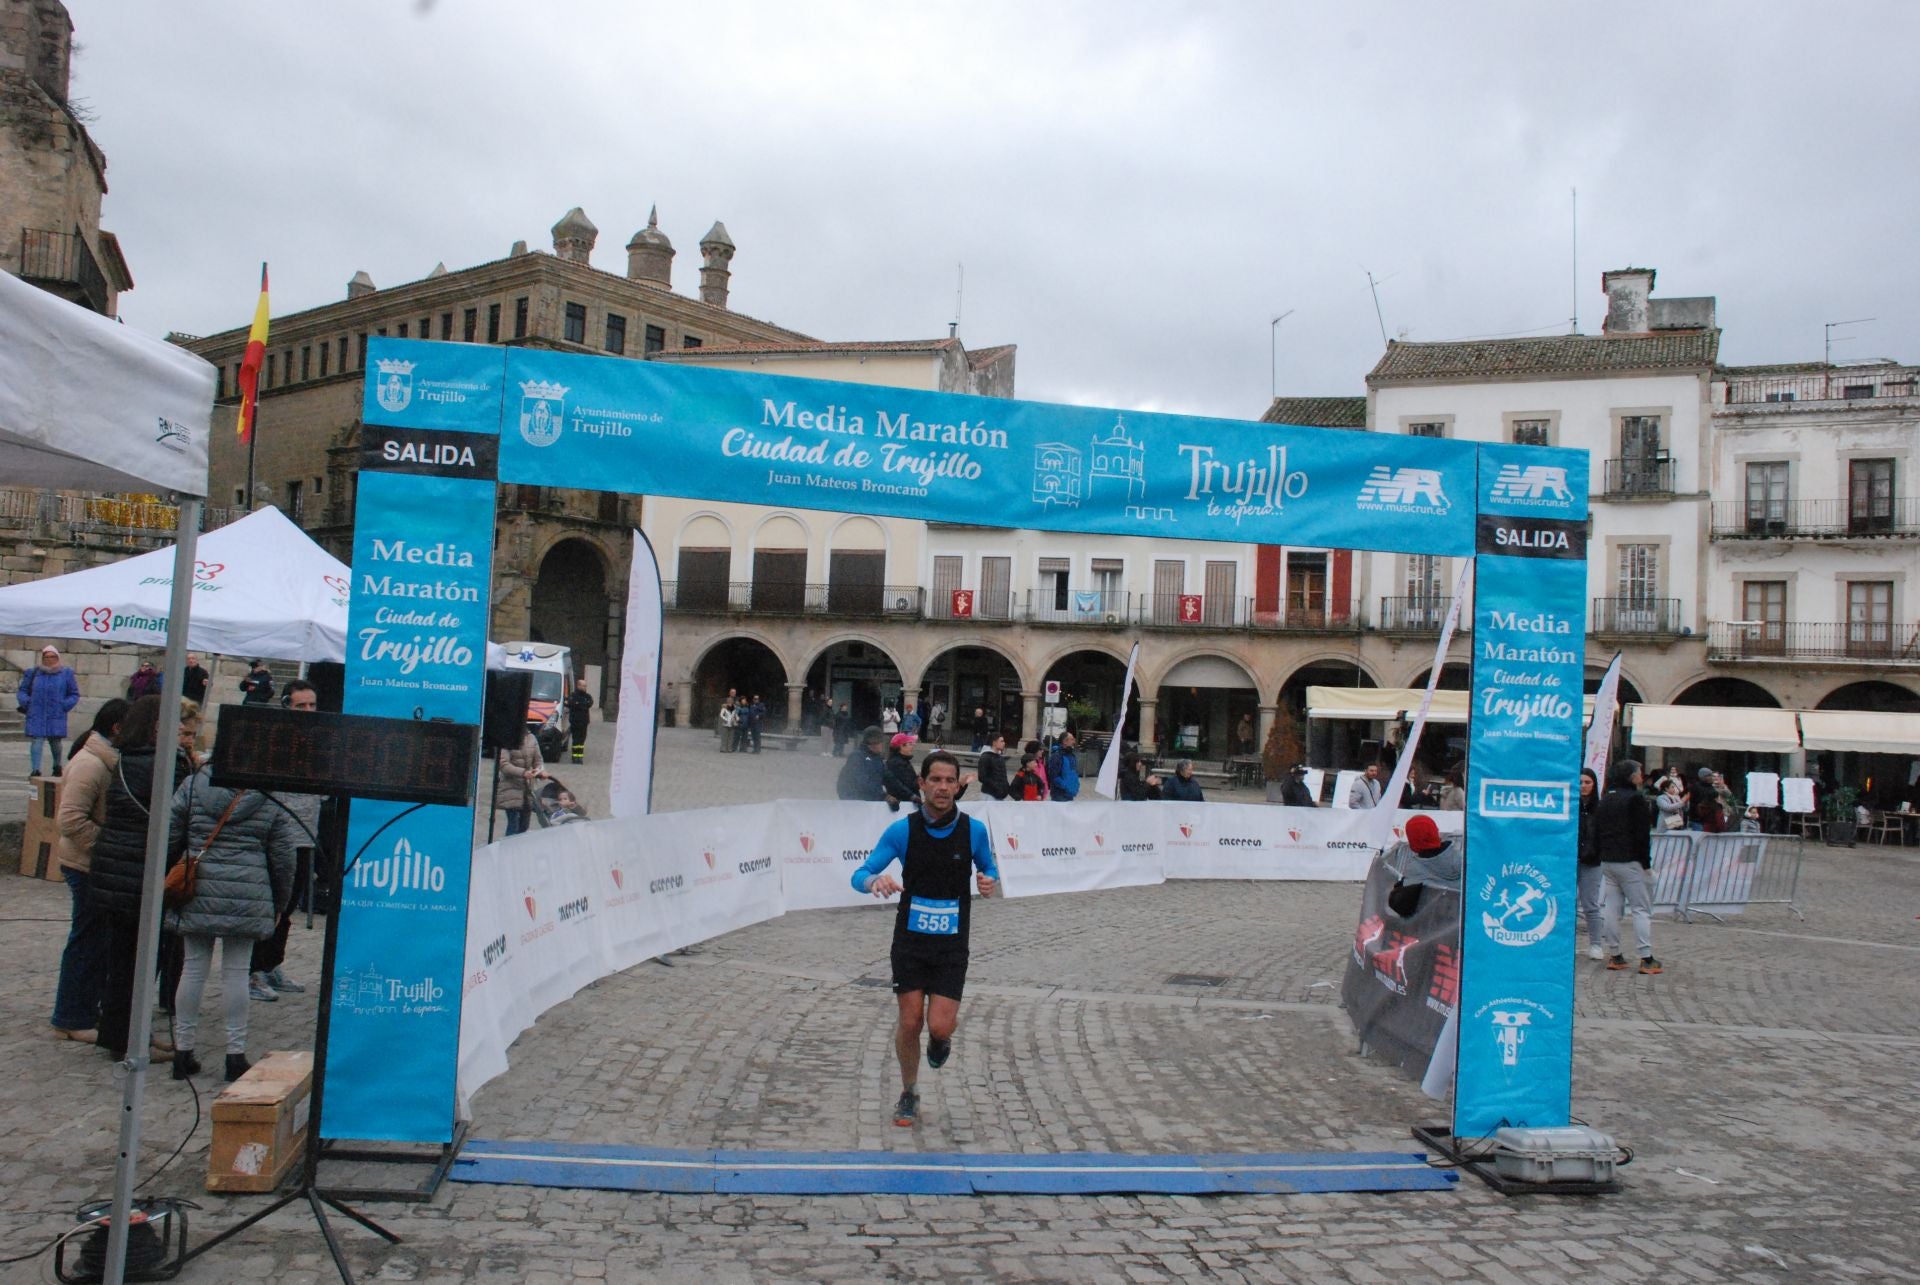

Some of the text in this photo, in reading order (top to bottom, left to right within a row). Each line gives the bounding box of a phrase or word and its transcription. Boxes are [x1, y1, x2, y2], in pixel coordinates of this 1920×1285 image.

[418, 389, 466, 405] Trujillo
[573, 405, 664, 423] Ayuntamiento de
[761, 398, 1008, 449] Media Maratón
[571, 418, 632, 438] Trujillo
[383, 440, 476, 467] SALIDA
[721, 428, 983, 486] Ciudad de Trujillo
[767, 470, 929, 497] Juan Mateos Broncano
[1178, 443, 1309, 509] Trujillo
[1207, 496, 1221, 516] te
[1356, 501, 1448, 516] www.musicrun.es
[1489, 495, 1570, 508] www.musicrun.es
[1495, 527, 1569, 549] SALIDA
[371, 539, 474, 568] Media
[361, 574, 479, 602] Maratón
[375, 606, 461, 628] Ciudad de
[1489, 610, 1571, 634] Media
[359, 627, 473, 675] Trujillo
[1484, 641, 1577, 664] Maratón
[360, 676, 468, 692] Juan Mateos Broncano
[1493, 668, 1562, 687] Ciudad de
[1481, 687, 1573, 727] Trujillo
[1483, 728, 1502, 739] Juan
[1492, 790, 1557, 809] HABLA
[354, 838, 445, 897] trujillo
[1480, 861, 1551, 900] Club Atletismo
[917, 912, 950, 932] 558
[1487, 925, 1540, 942] TRUJILLO
[385, 977, 444, 1002] Trujillo
[1507, 1043, 1514, 1057] S
